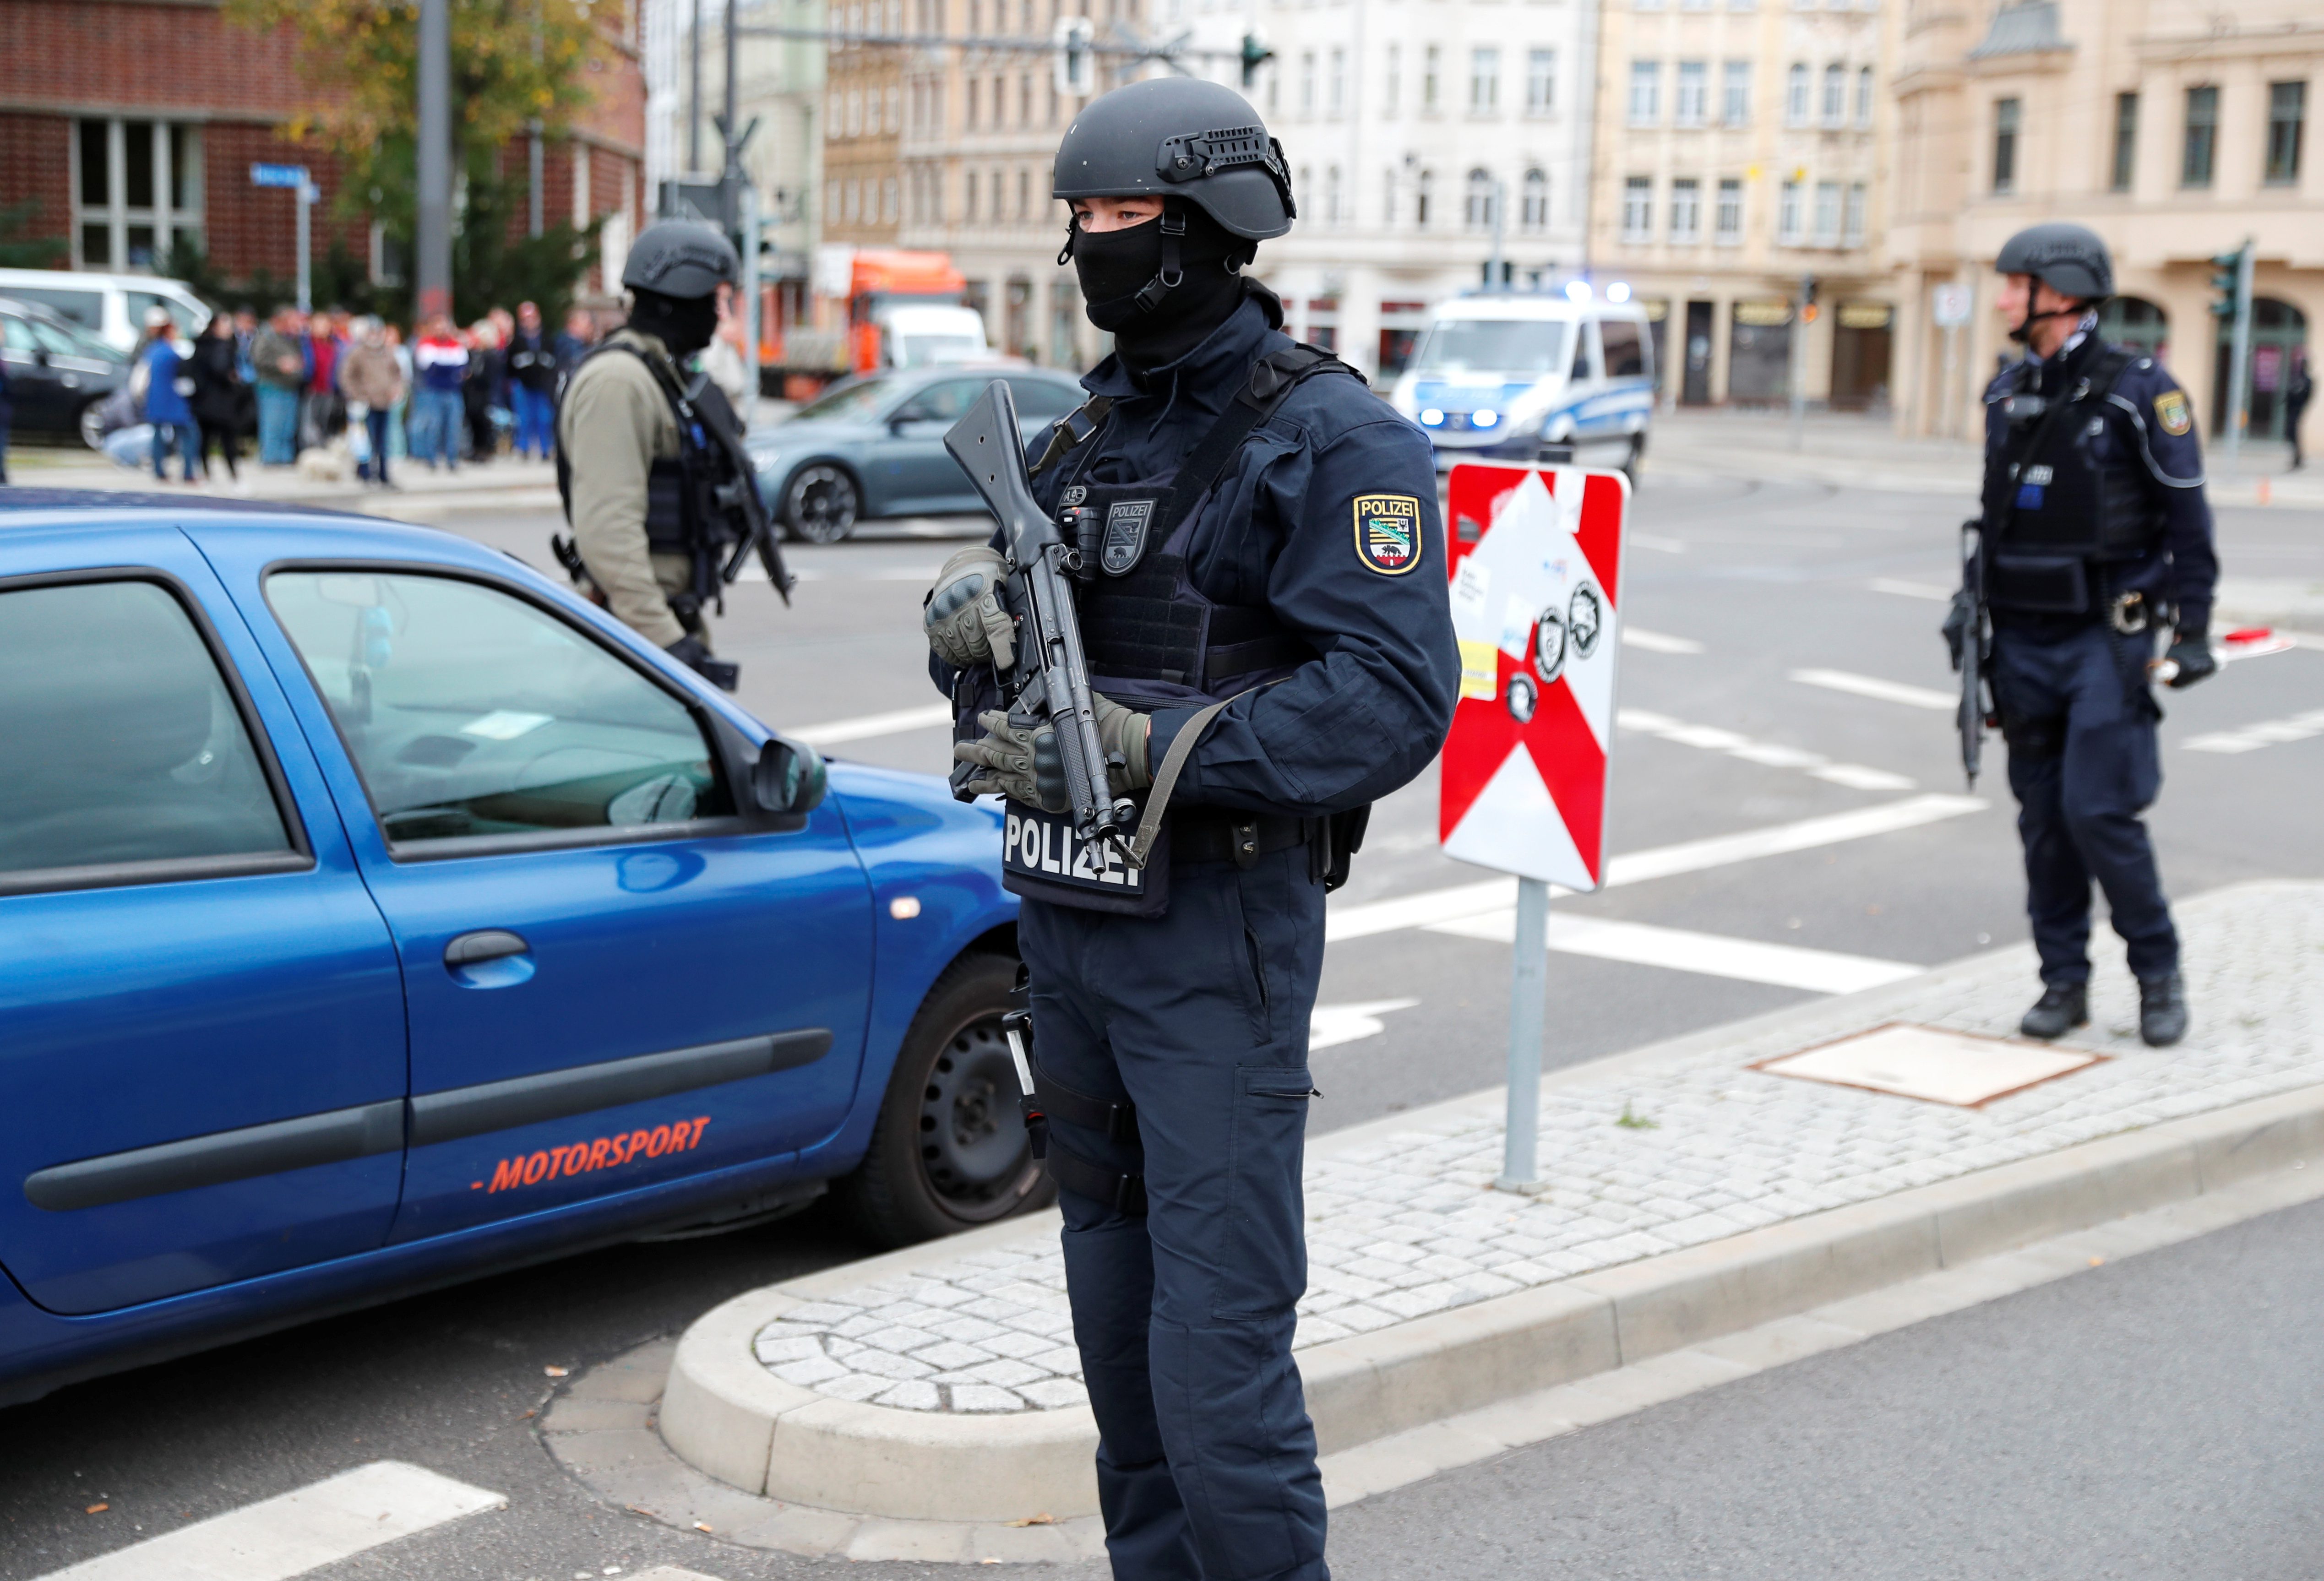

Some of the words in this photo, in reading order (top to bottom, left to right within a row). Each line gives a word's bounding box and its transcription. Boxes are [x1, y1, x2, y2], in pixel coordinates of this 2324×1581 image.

[1112, 505, 1148, 518] POLIZEI
[1361, 501, 1413, 517] POLIZEI
[487, 1115, 711, 1194] MOTORSPORT
